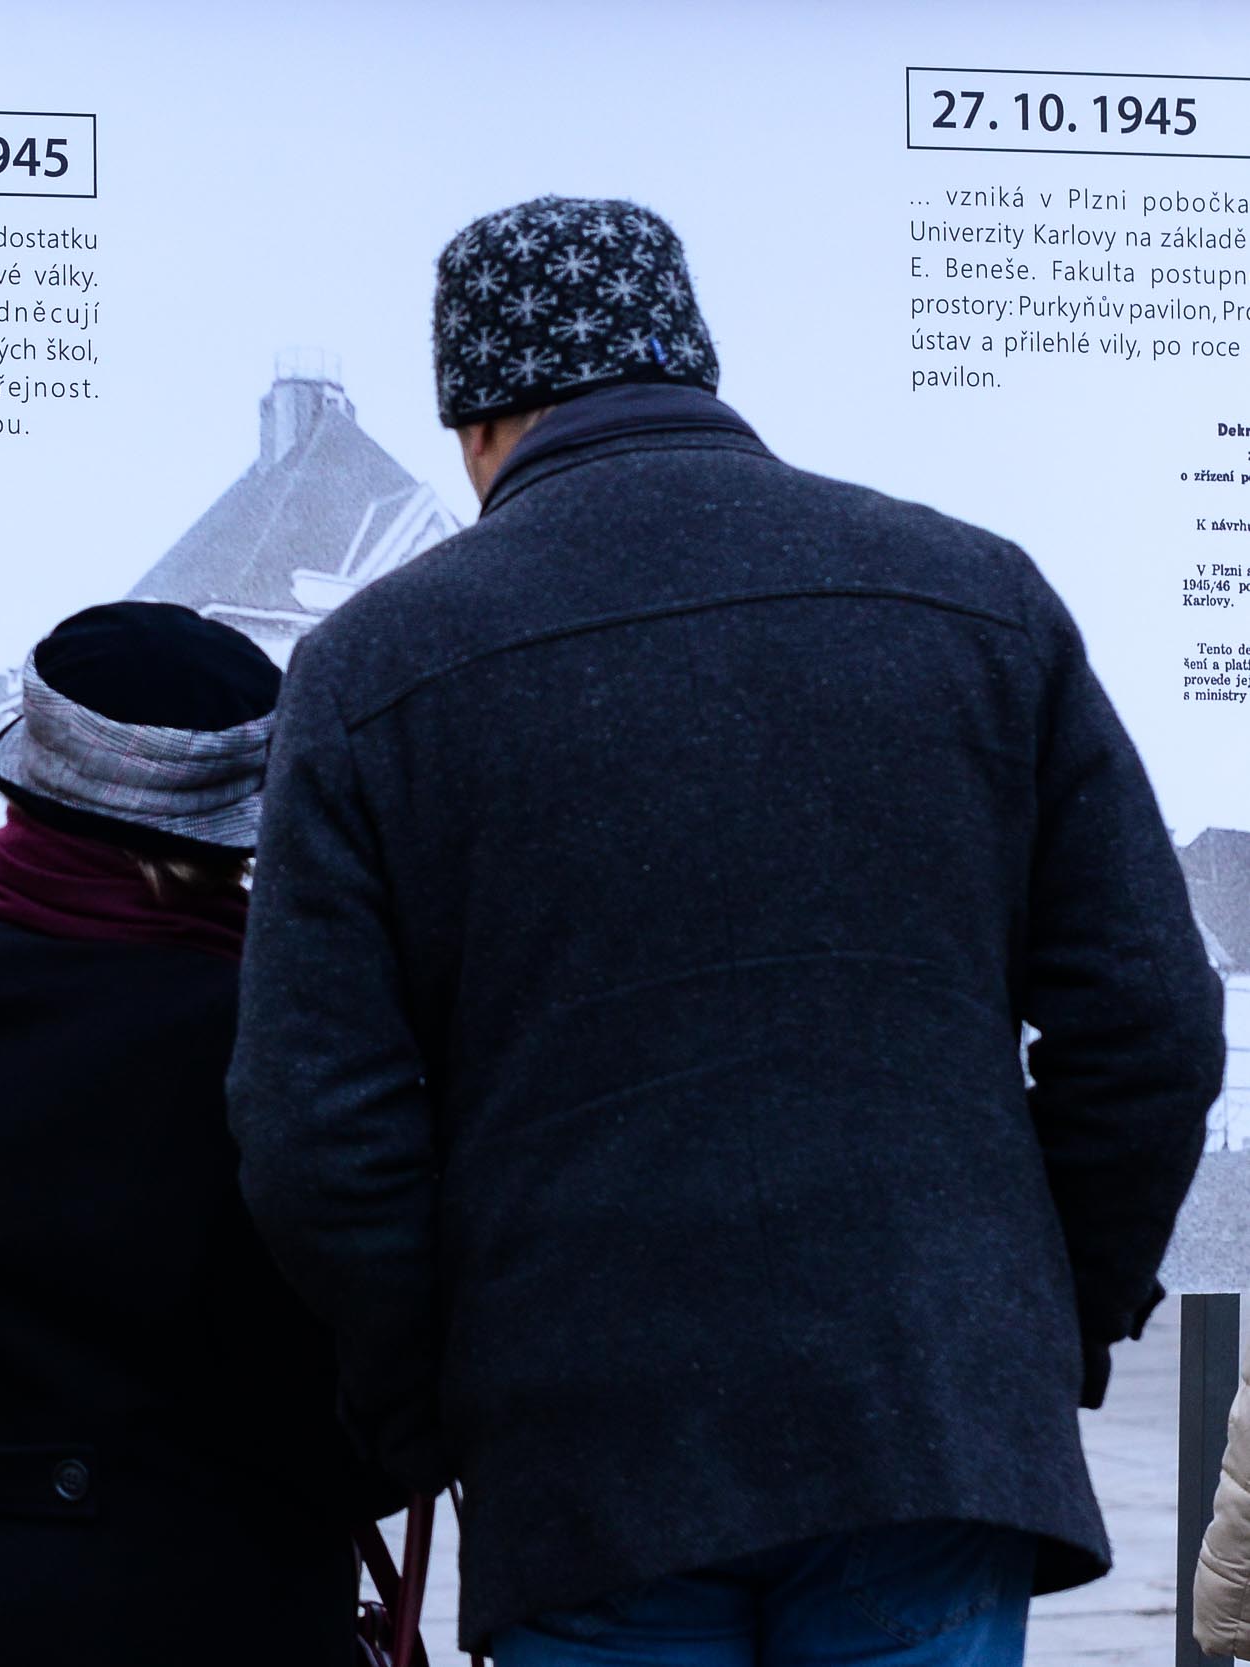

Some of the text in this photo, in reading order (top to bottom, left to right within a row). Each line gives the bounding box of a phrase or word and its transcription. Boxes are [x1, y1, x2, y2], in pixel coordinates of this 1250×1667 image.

[932, 89, 1197, 136] 27. 10. 1945
[945, 185, 1024, 208] vzniká
[1039, 192, 1052, 209] v
[1068, 187, 1126, 211] Plzni
[1143, 190, 1249, 217] pobočka
[910, 219, 1247, 253] Univerzity Karlovy na základě
[33, 263, 98, 294] války.
[911, 256, 929, 278] E.
[946, 257, 1036, 281] Beneše.
[1052, 259, 1135, 283] Fakulta
[911, 295, 1013, 322] prostory:
[1019, 295, 1125, 324] Purkyňův
[1129, 297, 1217, 325] pavilon,
[46, 337, 98, 365] škol,
[911, 327, 1240, 361] ústav a přilehlé vily, po roce
[912, 364, 1001, 393] pavilon.
[1180, 472, 1188, 482] o
[1193, 469, 1235, 483] zřízení
[1196, 517, 1250, 532] K návrh
[1195, 563, 1207, 577] V
[1211, 563, 1243, 577] Plzni
[1182, 593, 1235, 609] Karlovy.
[1196, 642, 1233, 656] Tento
[1212, 661, 1220, 671] a
[1224, 657, 1250, 673] plat
[1183, 672, 1231, 688] provede
[1183, 687, 1248, 704] s ministry
